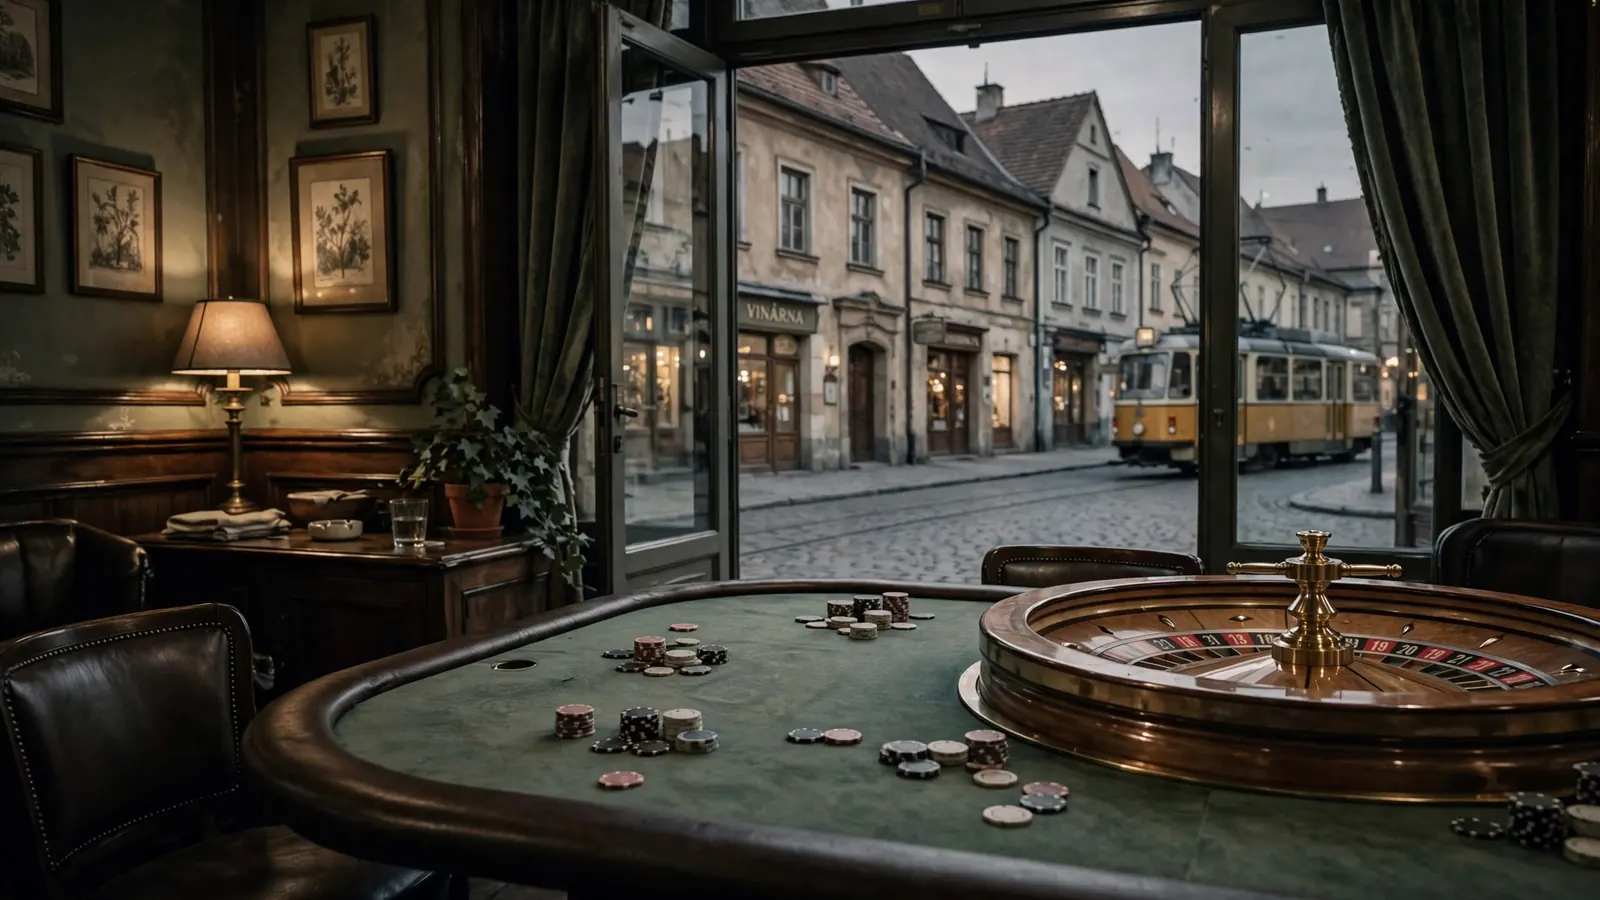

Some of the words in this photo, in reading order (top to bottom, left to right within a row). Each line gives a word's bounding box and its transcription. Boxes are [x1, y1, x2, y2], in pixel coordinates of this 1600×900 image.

[746, 302, 804, 325] VINÁRNA
[1371, 640, 1389, 652] 19
[1395, 644, 1419, 655] 20
